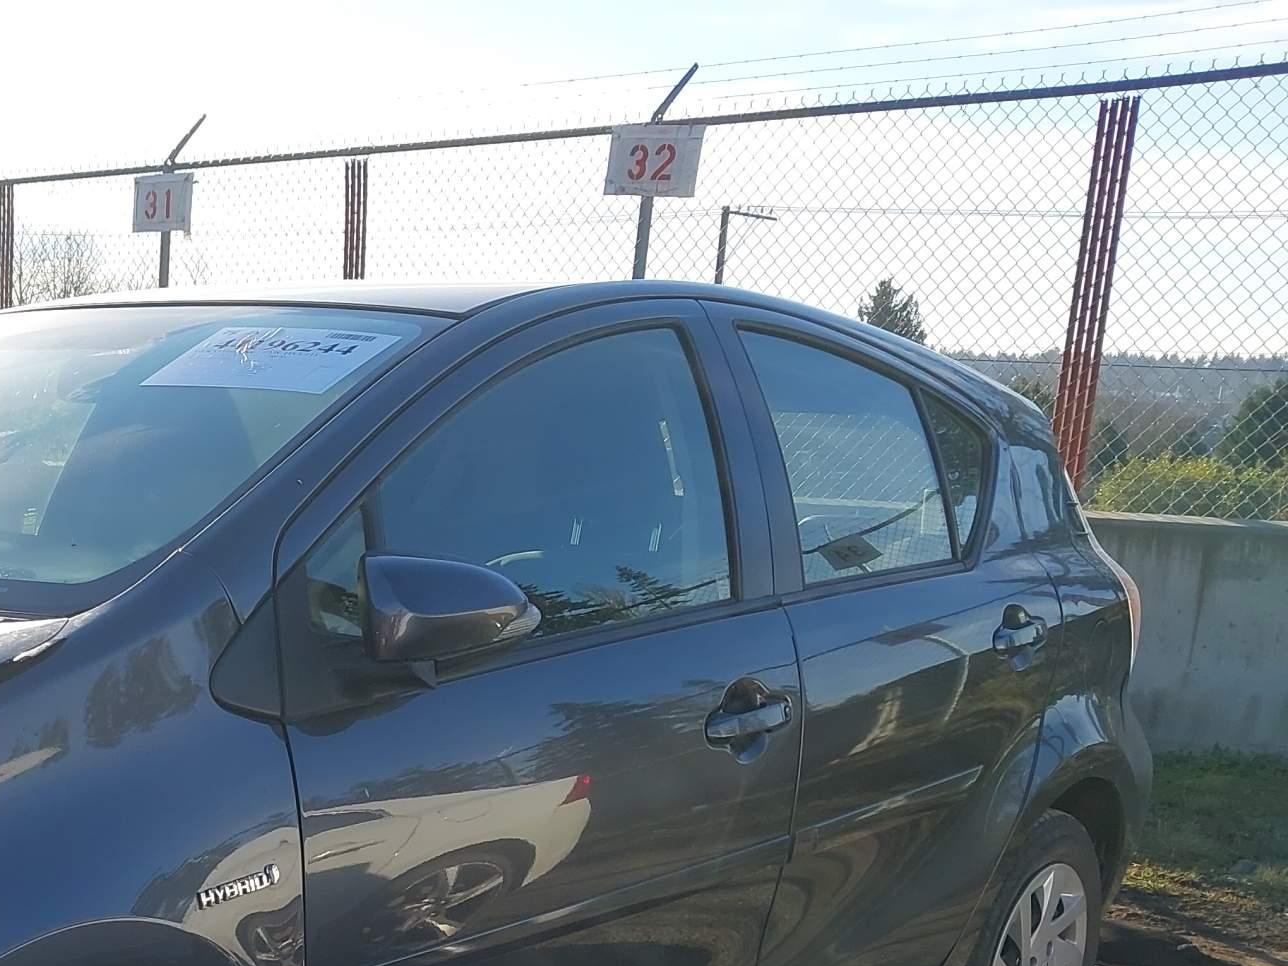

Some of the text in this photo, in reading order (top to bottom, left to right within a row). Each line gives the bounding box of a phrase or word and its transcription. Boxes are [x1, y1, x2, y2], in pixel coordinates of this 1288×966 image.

[627, 143, 677, 181] 32
[144, 188, 171, 220] 31
[198, 873, 270, 909] HYBRID
